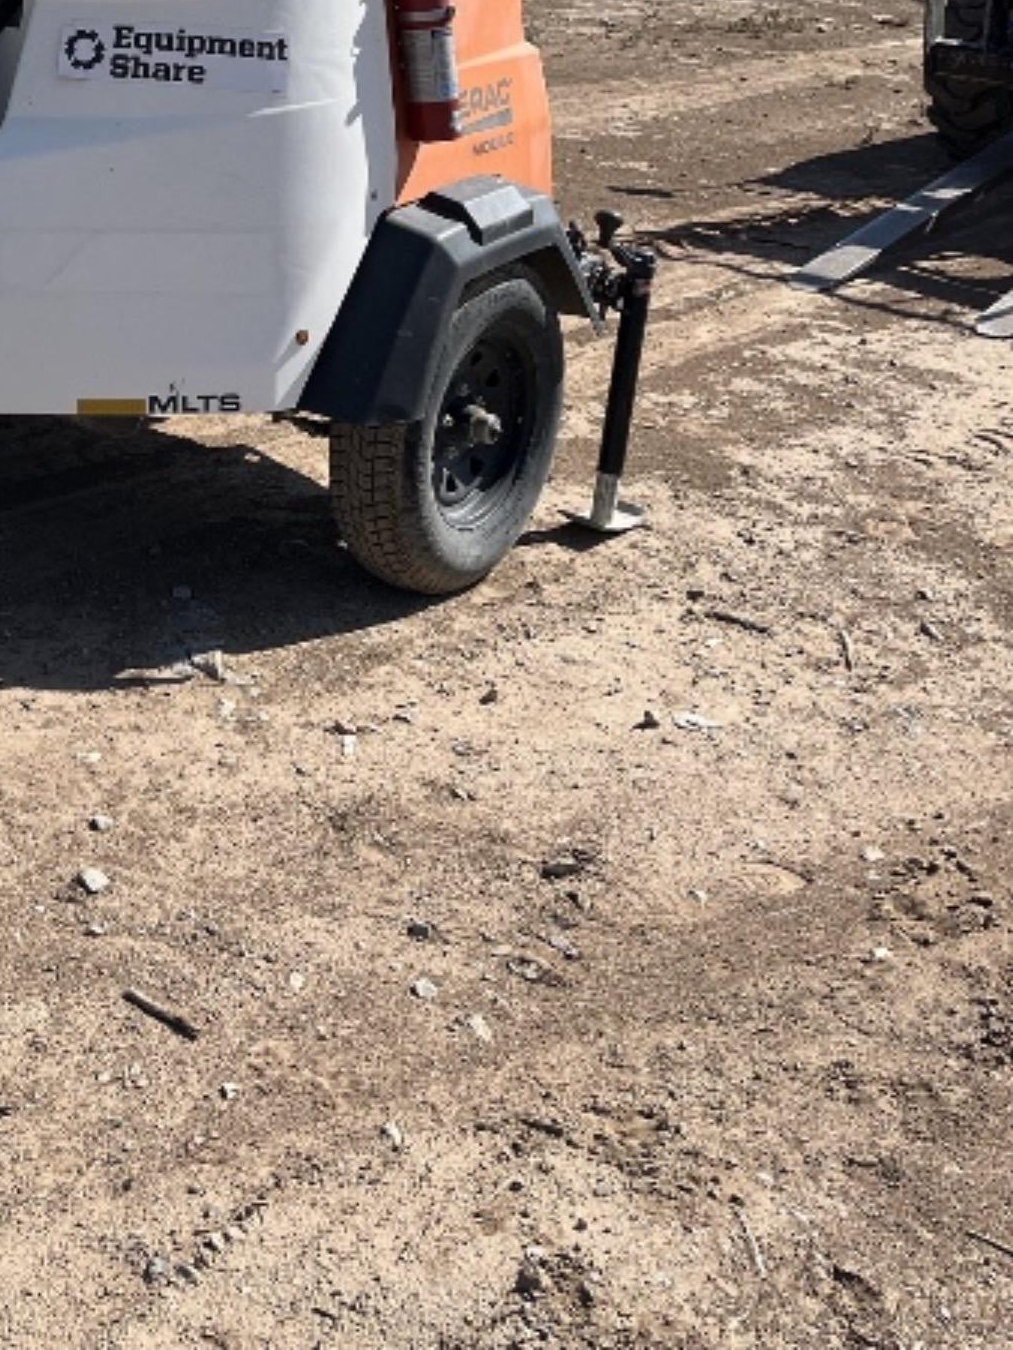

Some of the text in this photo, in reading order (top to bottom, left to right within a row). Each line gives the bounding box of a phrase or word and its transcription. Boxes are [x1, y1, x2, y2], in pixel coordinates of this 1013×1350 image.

[112, 25, 289, 61] Equipment
[109, 53, 207, 85] Share
[148, 393, 240, 414] MLTS
